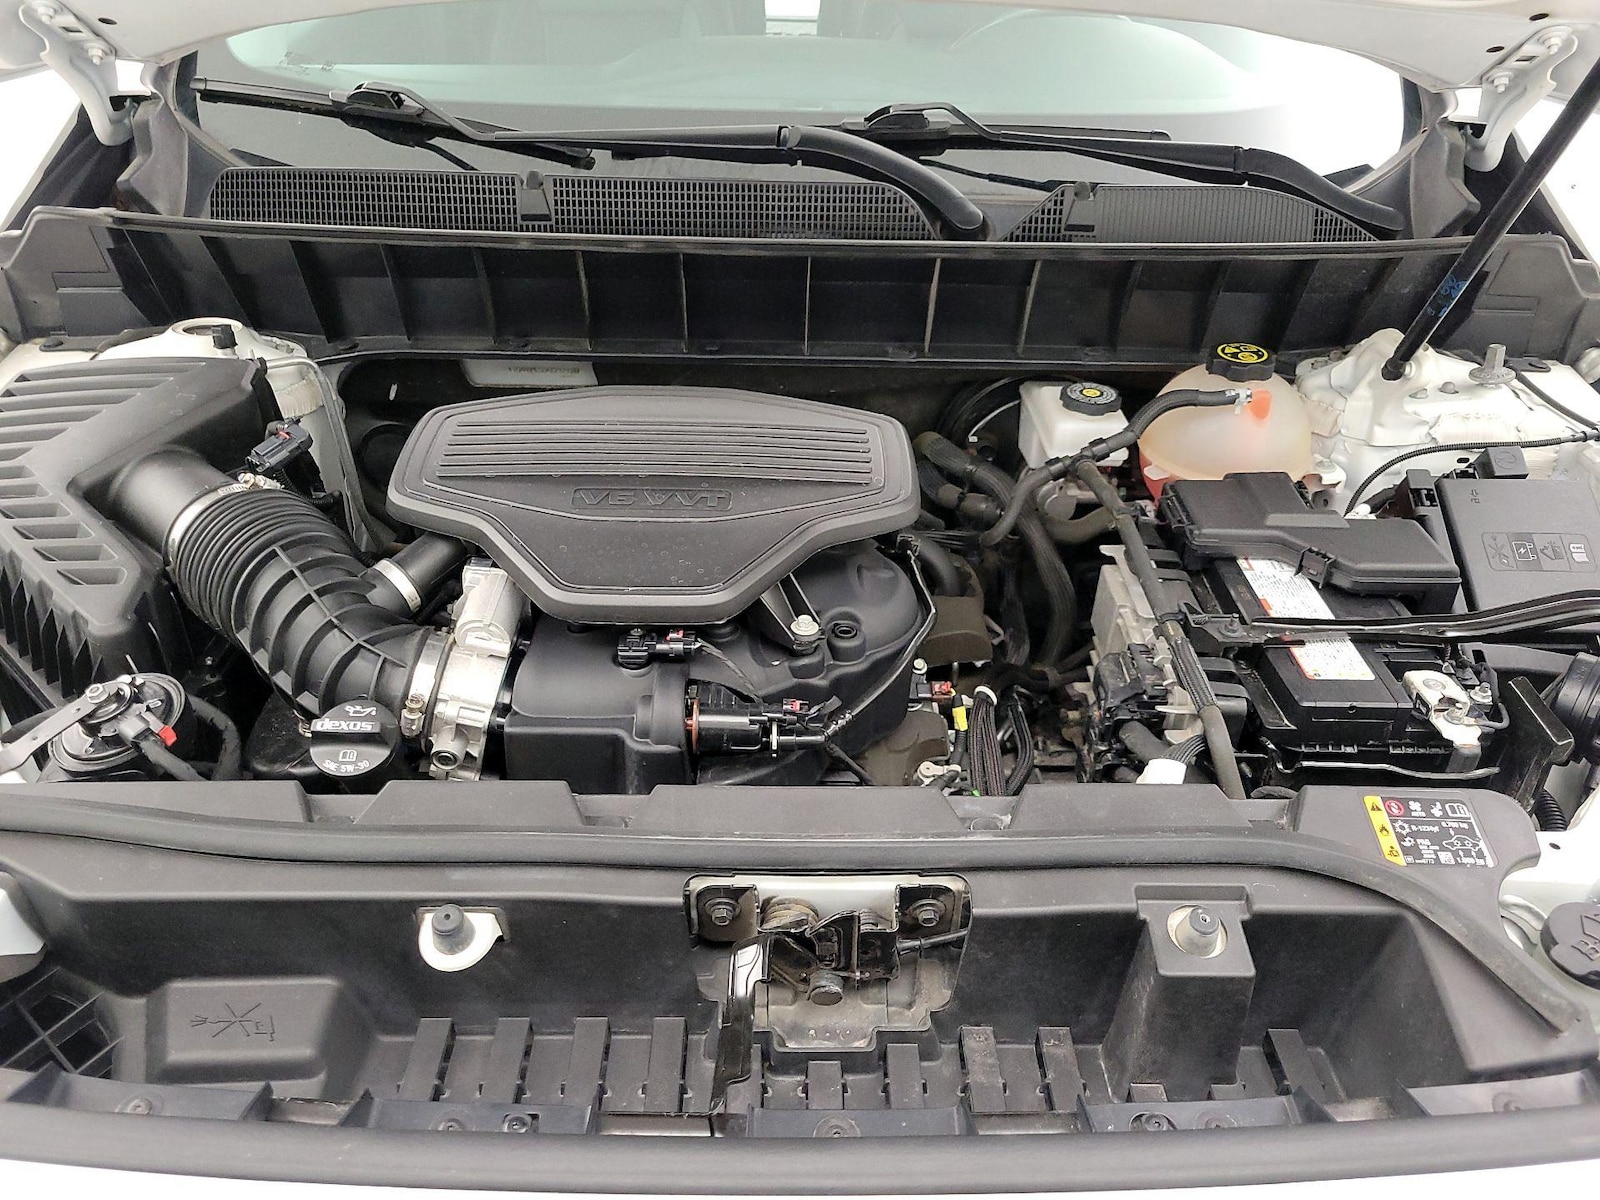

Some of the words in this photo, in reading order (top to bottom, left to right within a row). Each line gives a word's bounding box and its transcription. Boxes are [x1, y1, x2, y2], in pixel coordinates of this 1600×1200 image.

[579, 489, 635, 505] V6
[643, 489, 726, 507] VVT
[316, 718, 375, 731] dexos
[323, 760, 339, 771] SAE
[340, 760, 370, 772] 5W-30
